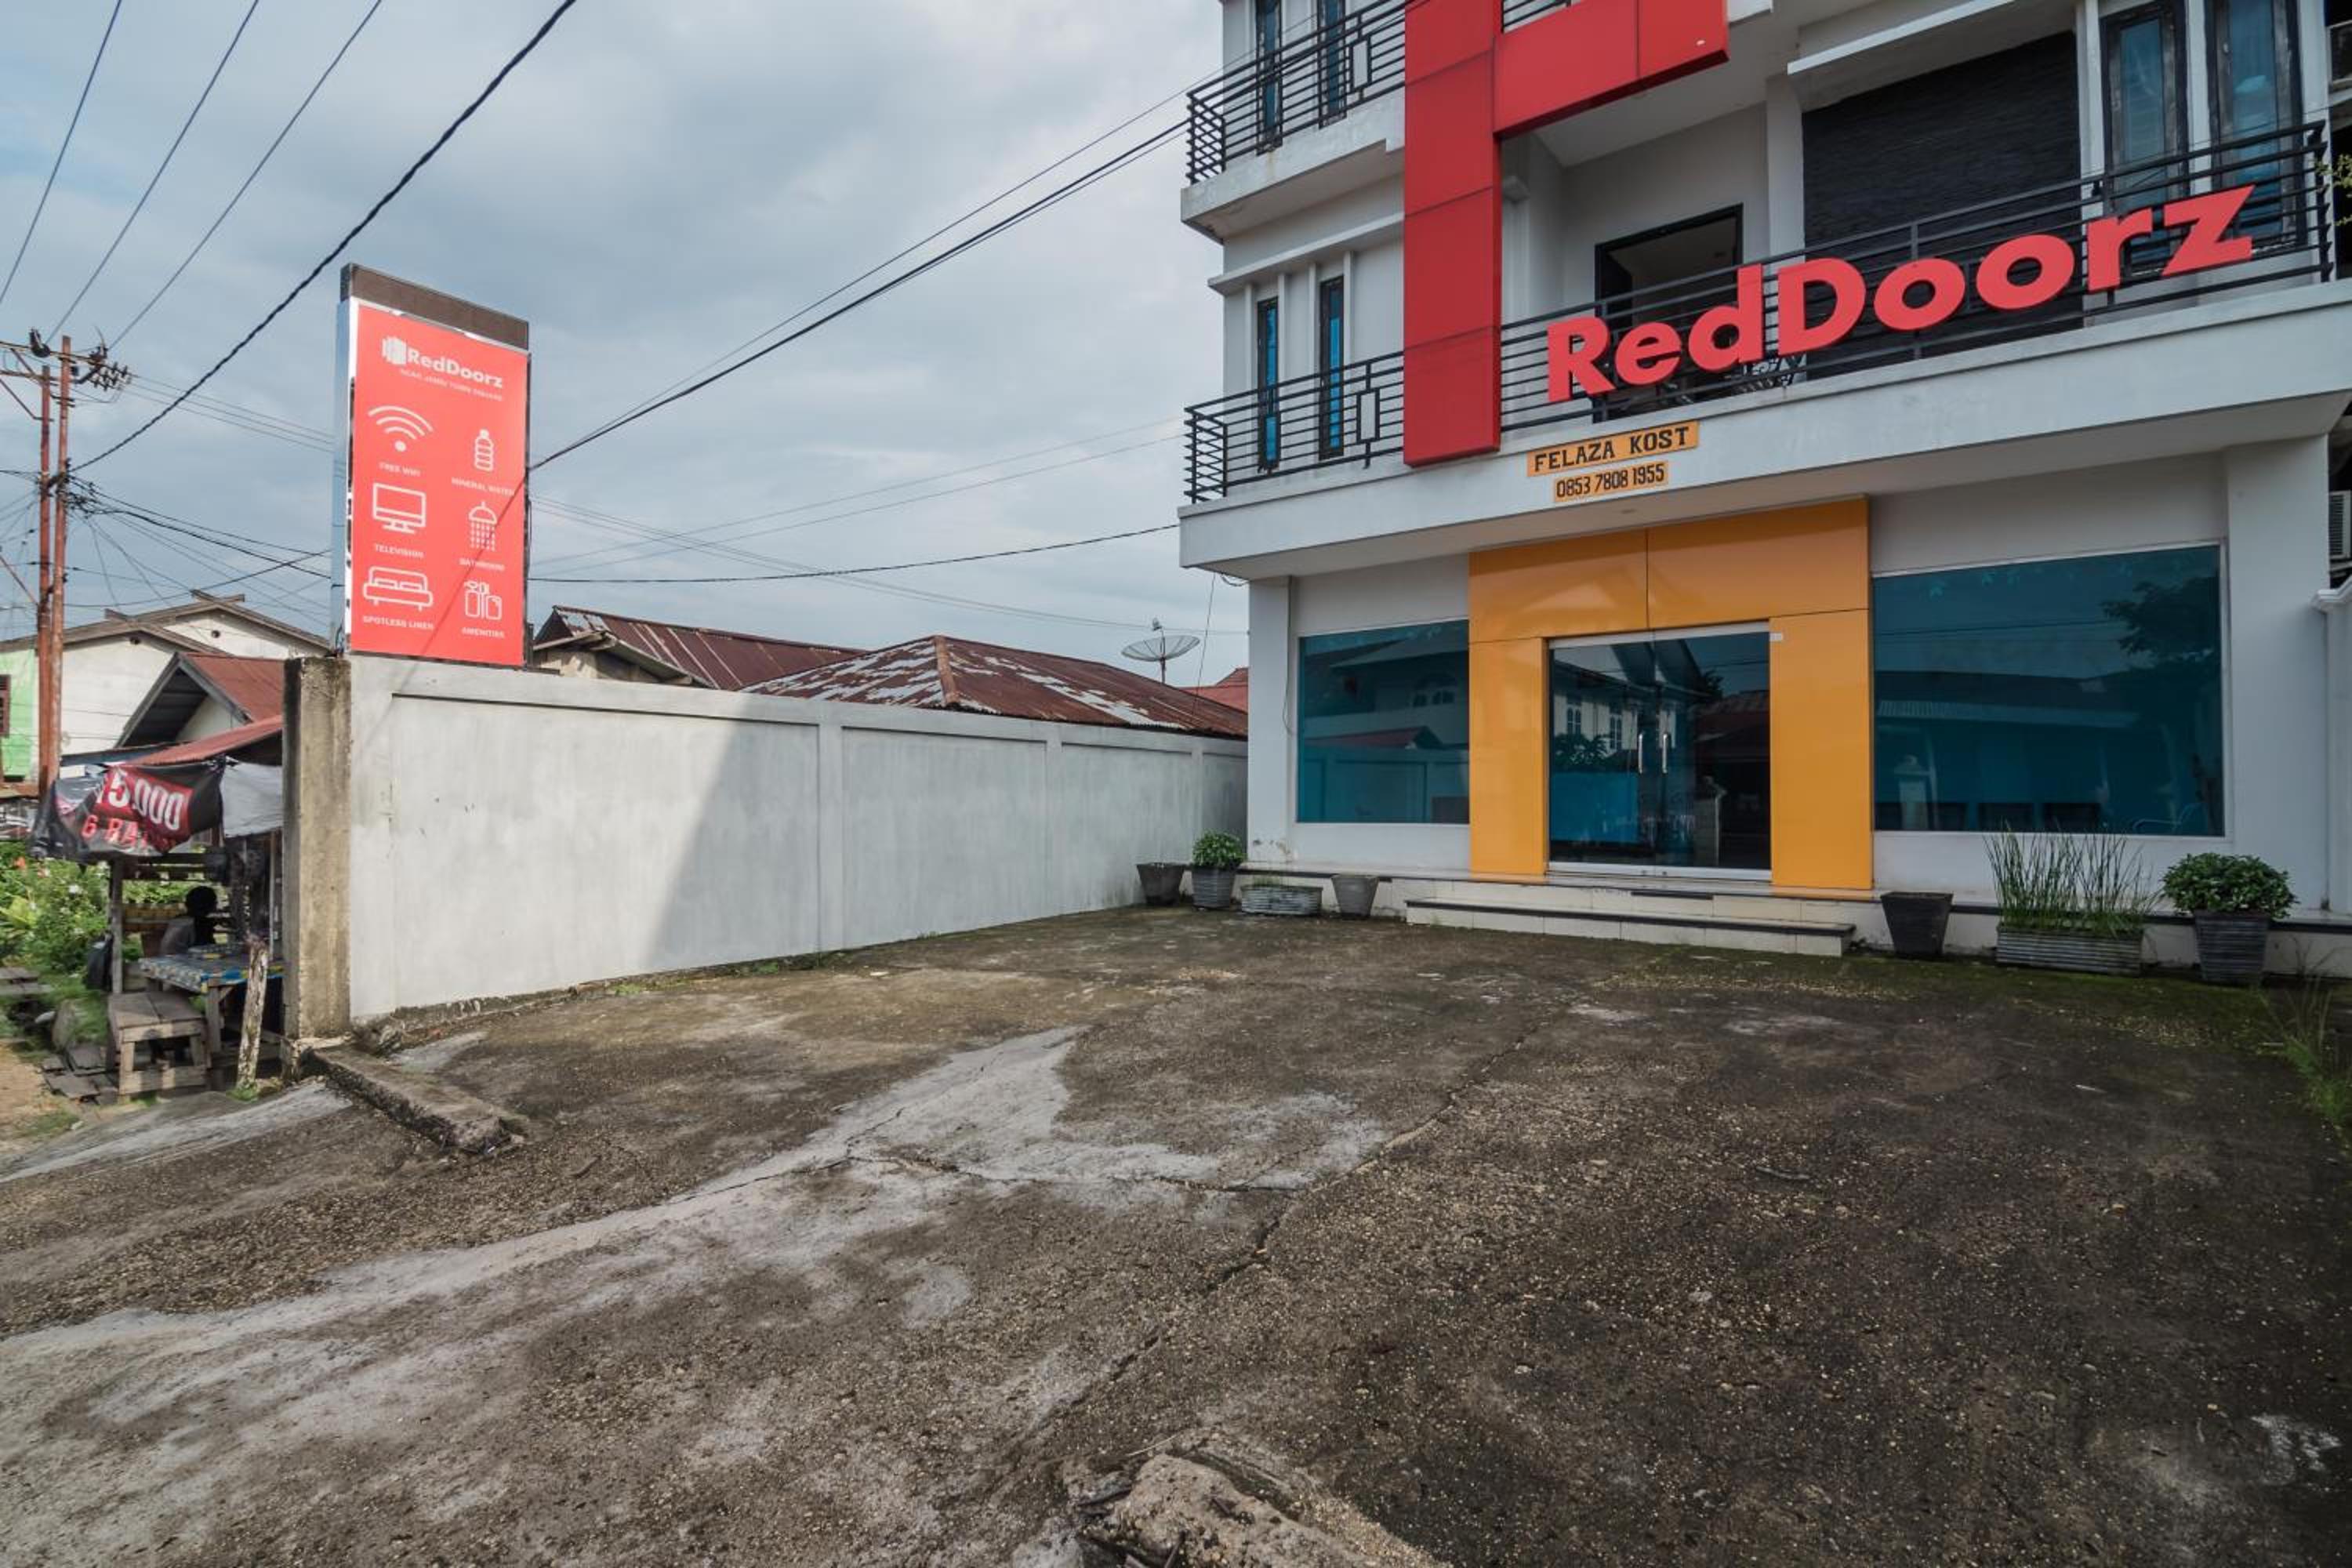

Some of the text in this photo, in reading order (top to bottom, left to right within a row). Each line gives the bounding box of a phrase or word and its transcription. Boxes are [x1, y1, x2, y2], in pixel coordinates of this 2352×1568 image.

[1547, 185, 2256, 403] RedDoorz
[407, 347, 503, 389] RedDoorz
[1534, 426, 1690, 472] FELAZA KOST
[451, 476, 486, 492] MINERAL
[1555, 463, 1665, 498] 0853 7808 1955
[374, 543, 425, 559] TELEVISION
[362, 615, 407, 629] SPOTLESS
